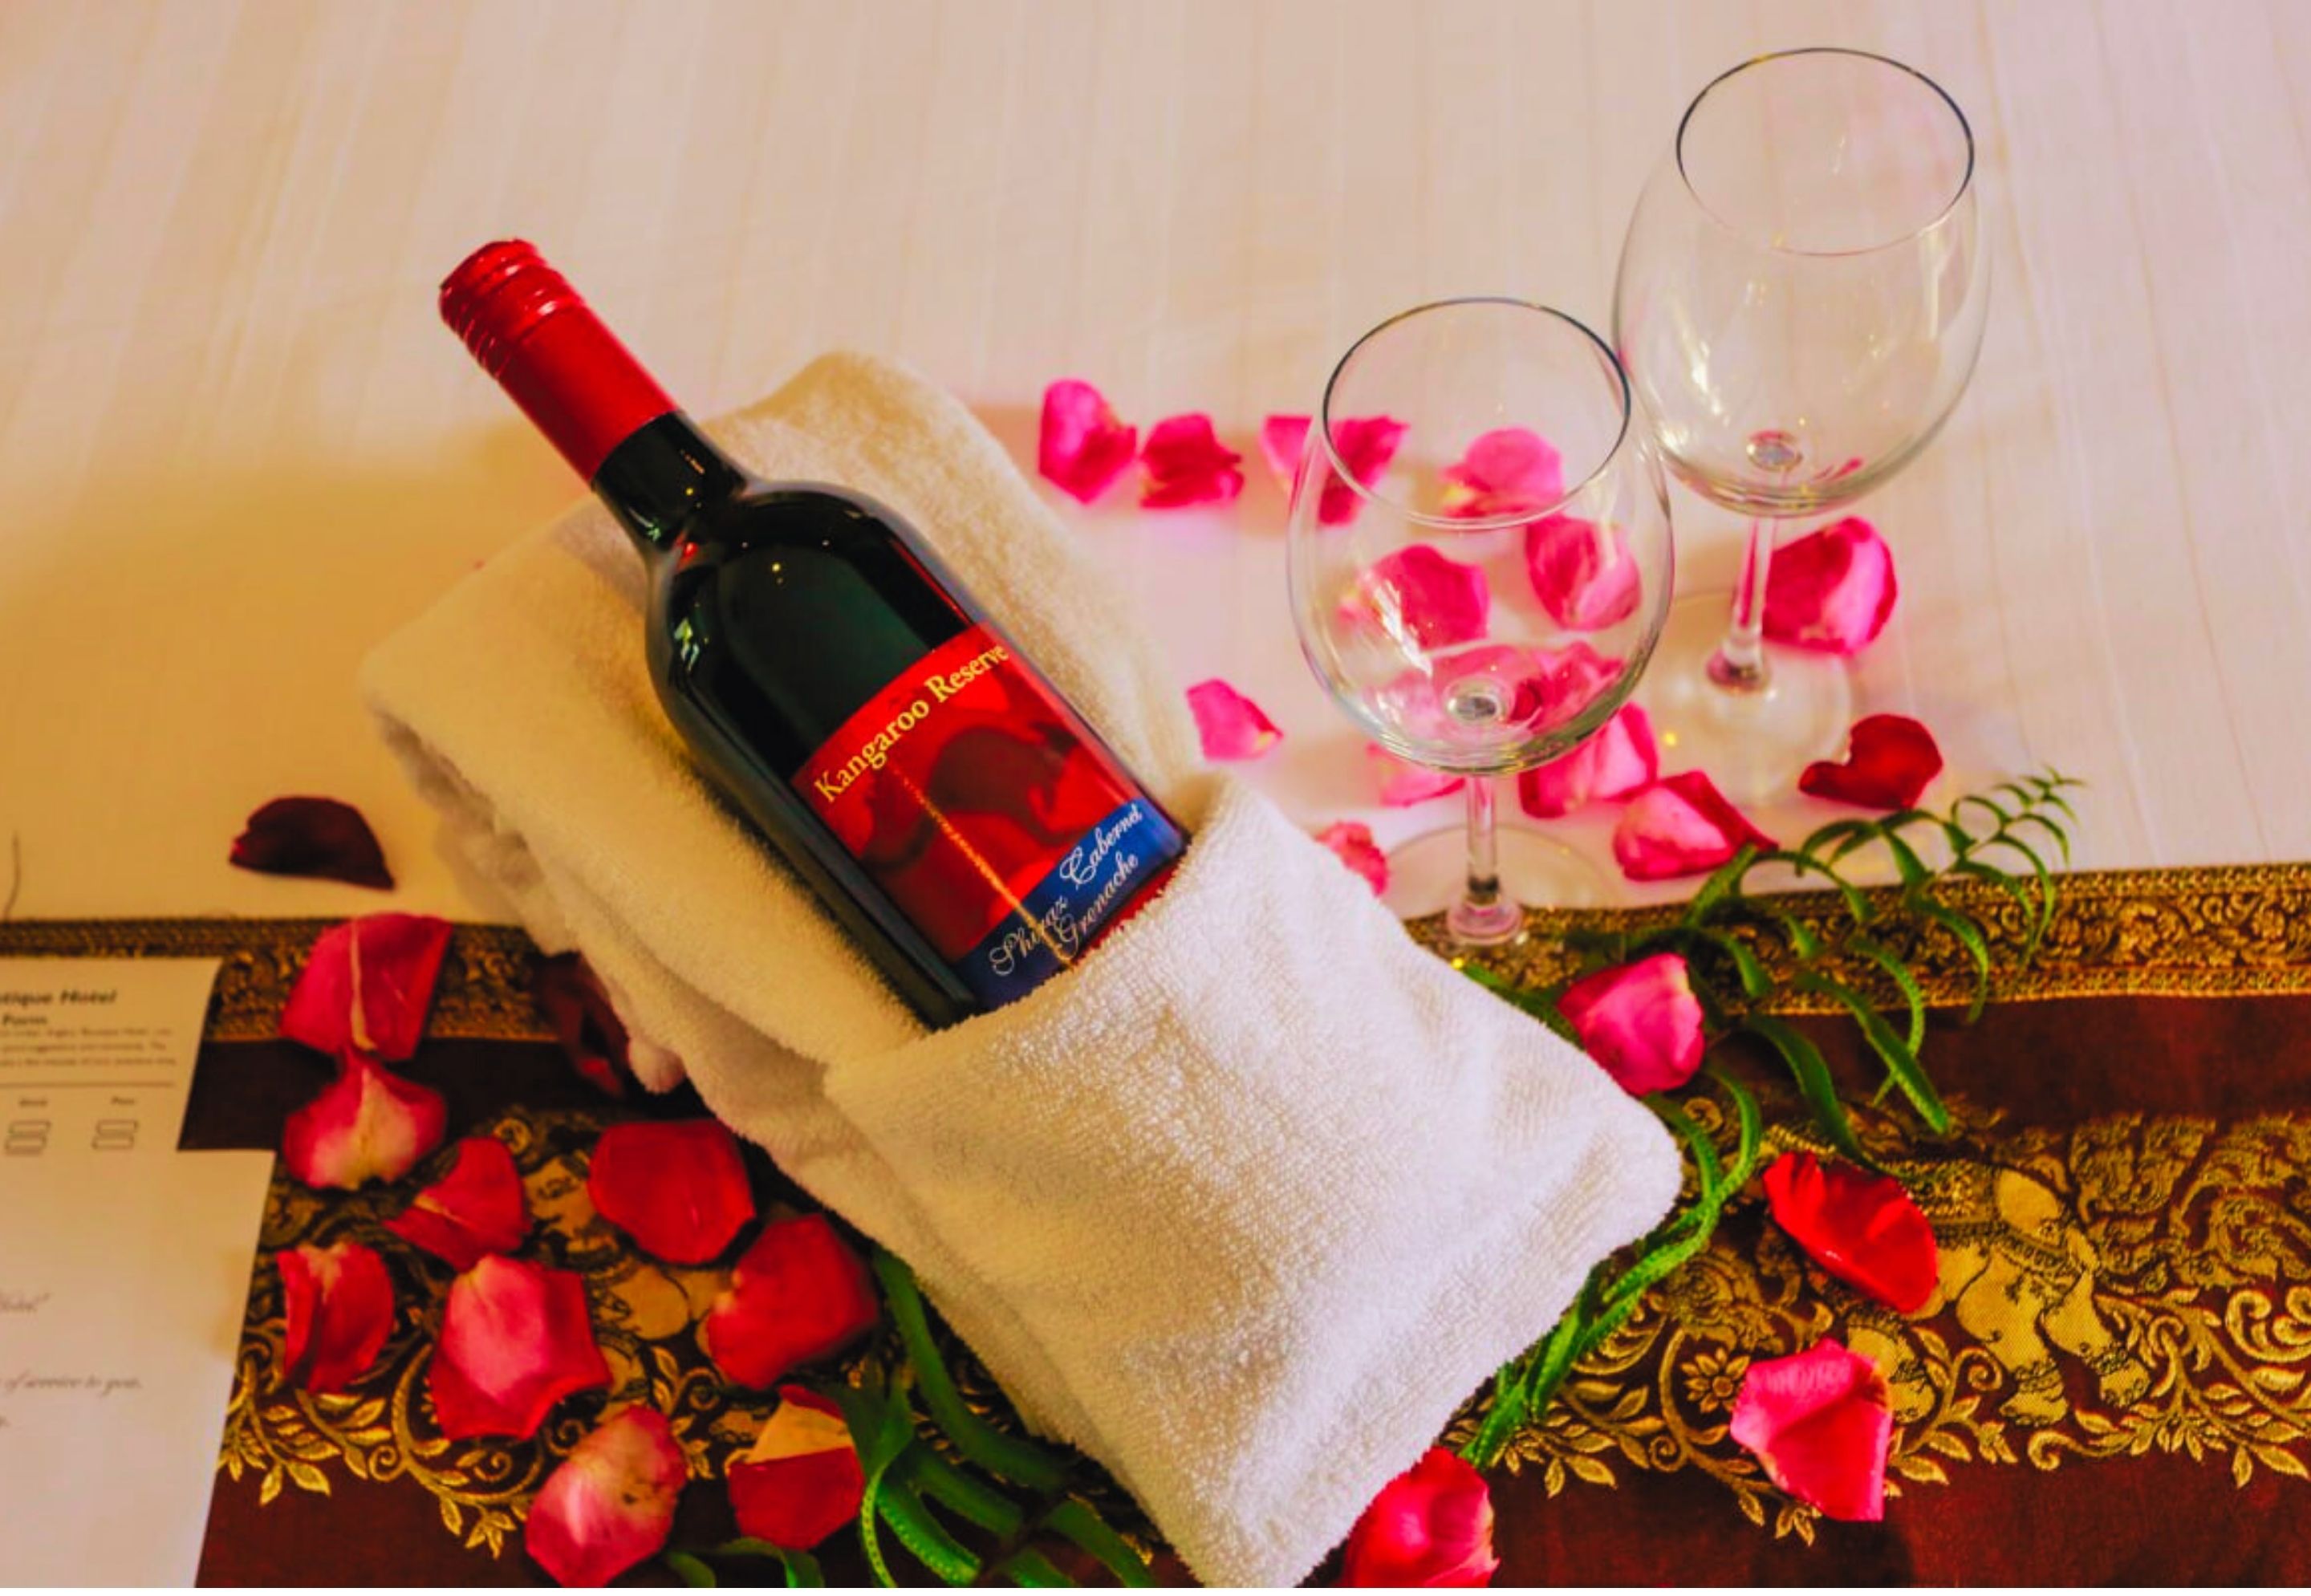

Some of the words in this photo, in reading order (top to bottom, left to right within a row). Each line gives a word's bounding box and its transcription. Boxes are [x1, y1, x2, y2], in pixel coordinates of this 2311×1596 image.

[813, 700, 929, 803] Kangaroo
[924, 644, 1009, 703] Reserve
[1059, 803, 1143, 891] Cabernet
[1053, 851, 1139, 961] Grenache
[60, 988, 117, 1005] Hotel
